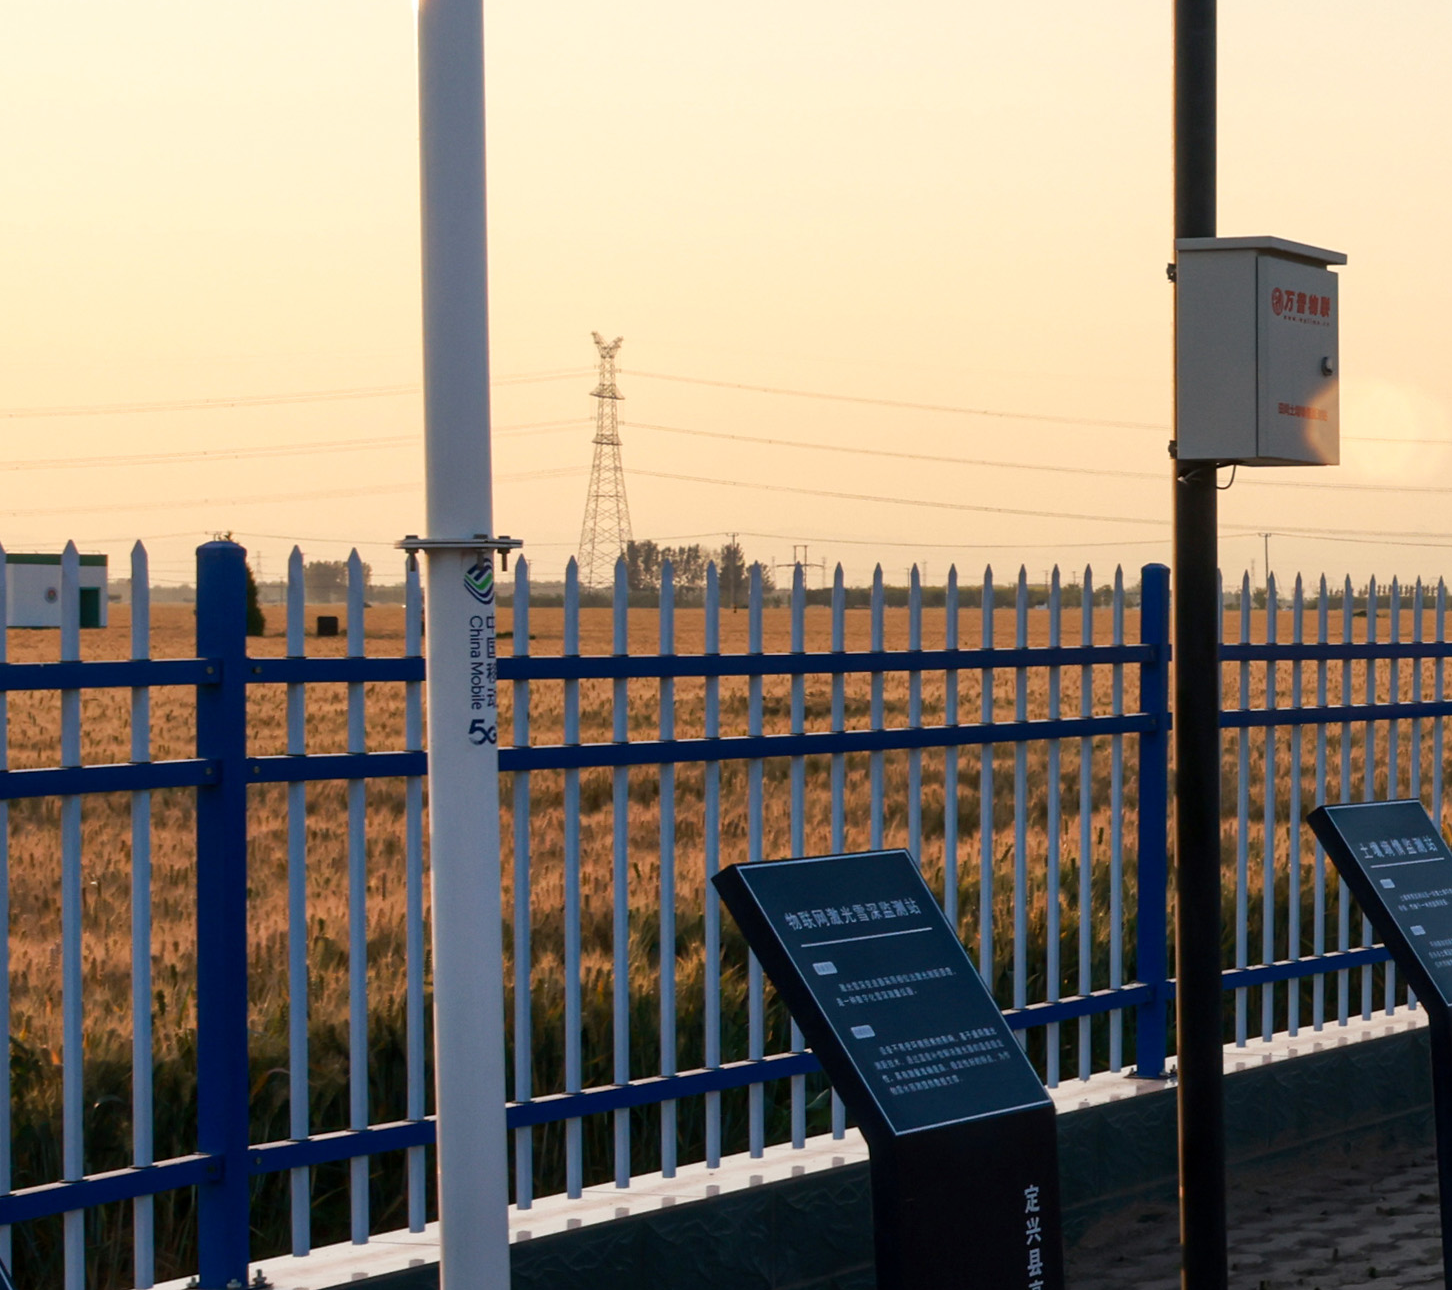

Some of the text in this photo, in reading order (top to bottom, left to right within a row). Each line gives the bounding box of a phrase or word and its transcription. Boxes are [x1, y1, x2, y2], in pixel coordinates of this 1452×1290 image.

[469, 615, 486, 710] China Mobile
[784, 897, 922, 931] 物联网激光雪深监测站
